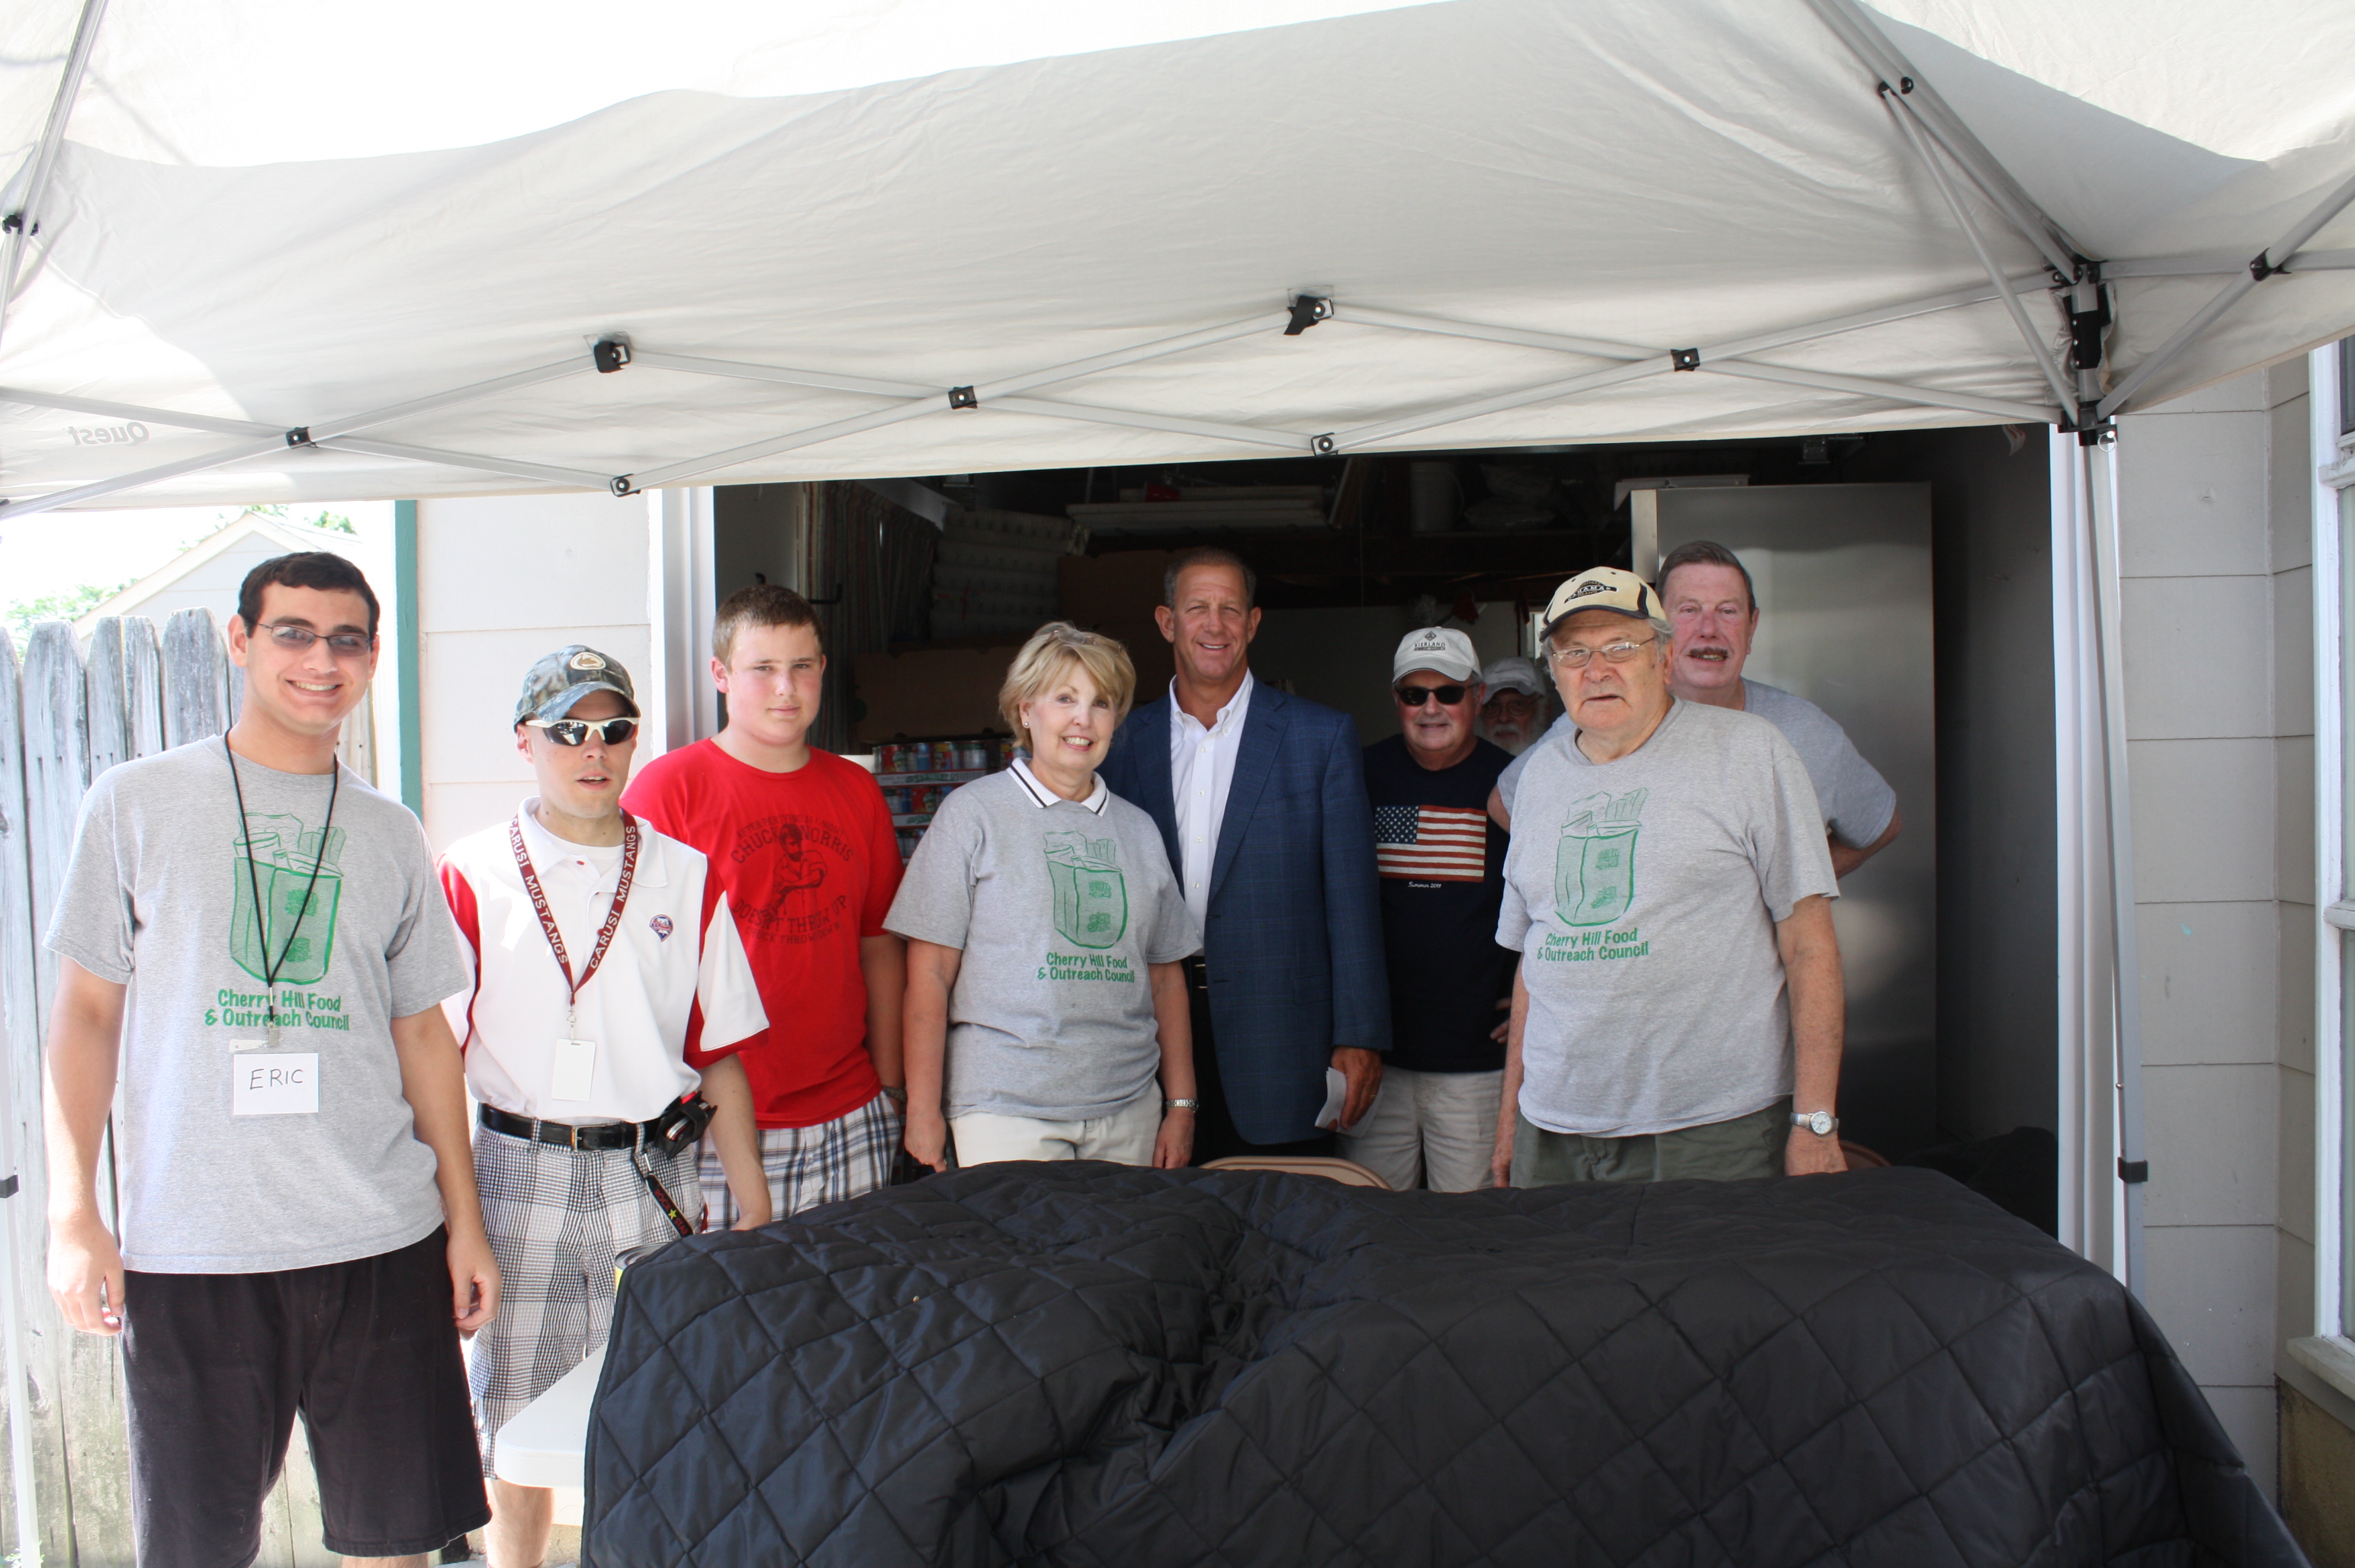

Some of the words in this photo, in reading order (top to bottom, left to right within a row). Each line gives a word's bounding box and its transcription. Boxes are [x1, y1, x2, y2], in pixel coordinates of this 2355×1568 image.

[731, 826, 780, 864] CHUCK
[800, 824, 853, 862] NORRIS
[509, 818, 530, 868] CARUSI
[525, 874, 569, 964] MUSTANGS
[590, 910, 621, 969] CARUSI
[616, 826, 636, 902] MUSTANGS
[732, 898, 784, 933] DOESNT
[831, 894, 847, 916] UP
[1545, 933, 1579, 949] Cherry
[1582, 930, 1602, 946] Hill
[1605, 927, 1638, 945] Food
[1046, 952, 1087, 968] Cherry
[1089, 953, 1104, 967] Hill
[1106, 955, 1128, 969] Food
[1537, 946, 1544, 959] &
[1544, 946, 1595, 962] Outreach
[1598, 940, 1650, 960] Council
[1037, 966, 1047, 980] &
[1050, 966, 1103, 980] Outreach
[1105, 969, 1135, 983] Council
[217, 988, 276, 1007] Cherry
[281, 990, 305, 1009] Hill
[307, 993, 342, 1012] Food
[204, 1009, 218, 1026] &
[223, 1008, 301, 1027] Outreach
[306, 1011, 350, 1031] Council
[249, 1068, 304, 1091] ERIC
[654, 1188, 672, 1212] ROCK
